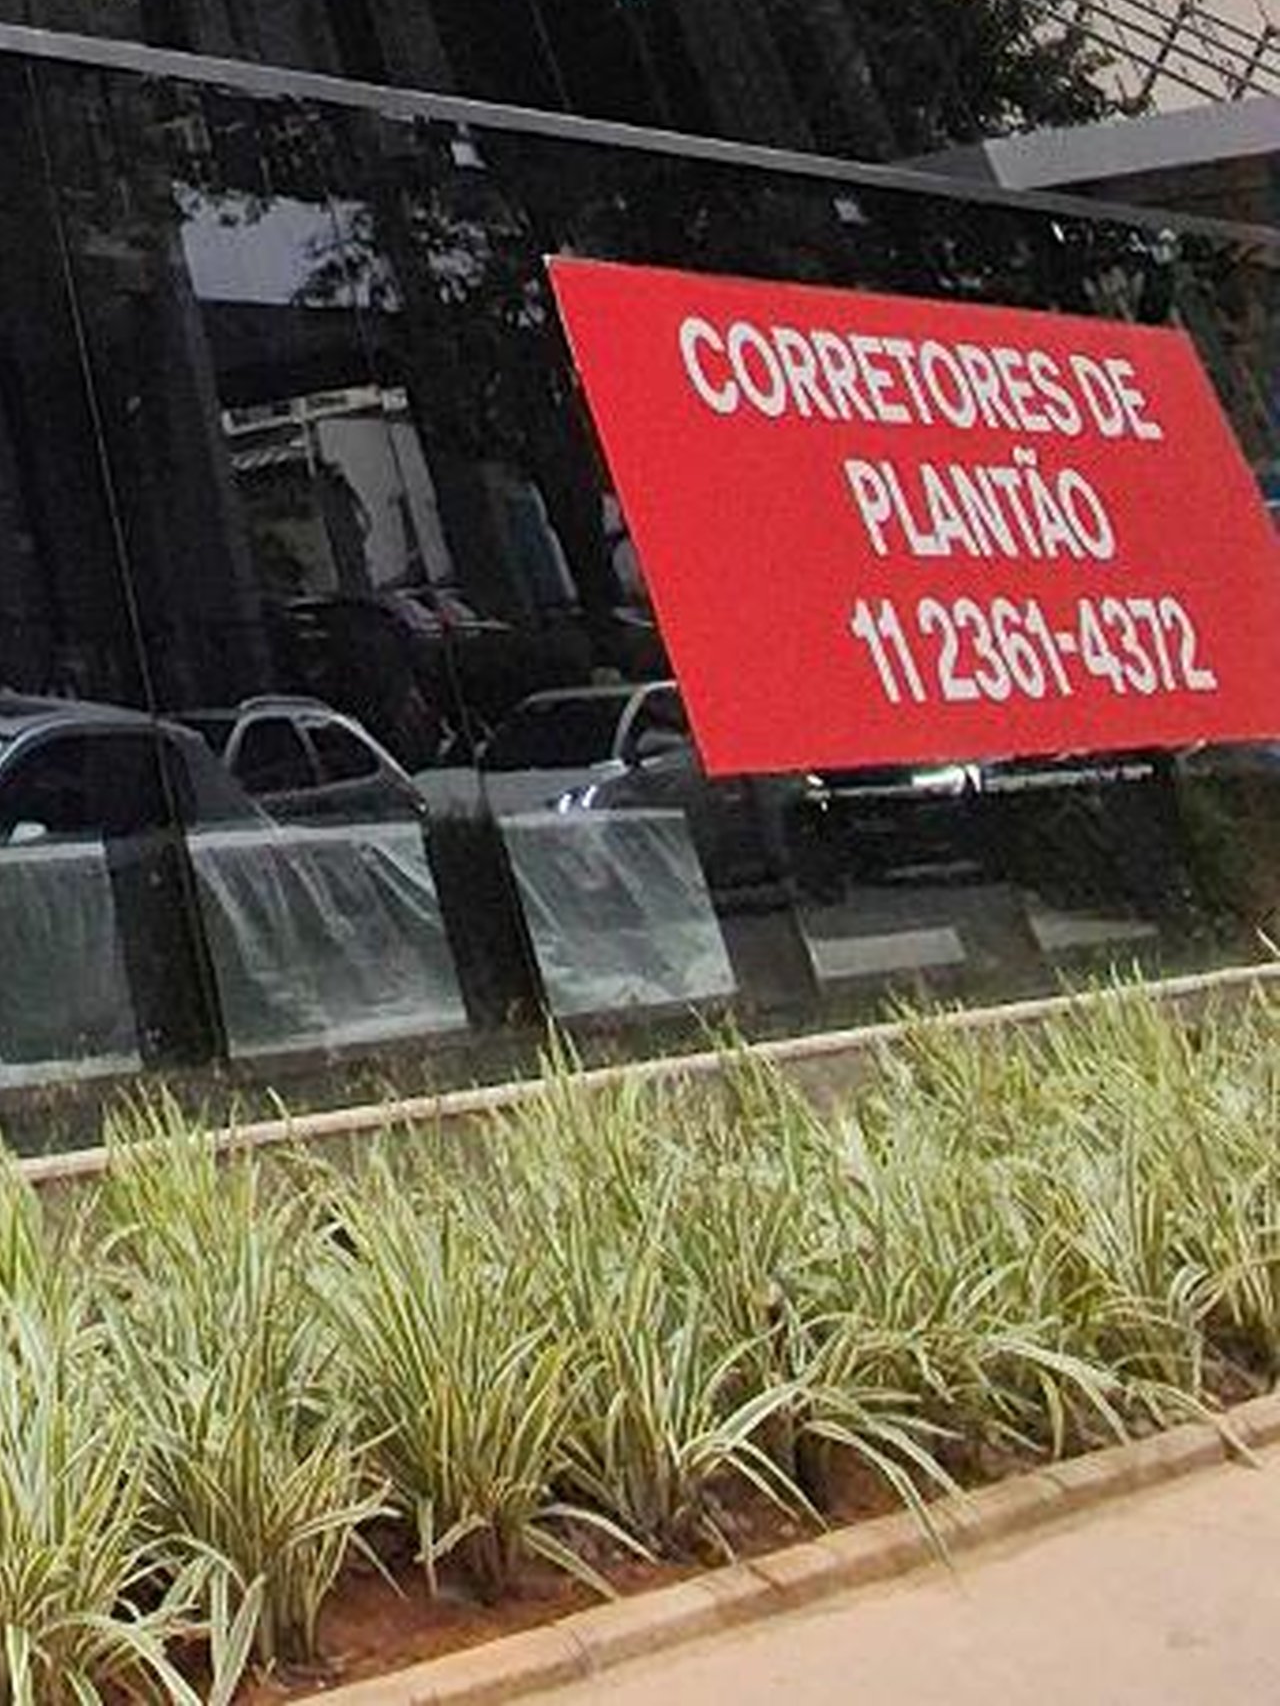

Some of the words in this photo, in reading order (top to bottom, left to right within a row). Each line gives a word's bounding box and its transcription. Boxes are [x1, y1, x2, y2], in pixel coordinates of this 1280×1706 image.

[677, 316, 1084, 437] CORRETORES
[1068, 354, 1163, 441] DE
[843, 445, 1117, 561] PLANTÃO
[850, 598, 926, 704] 11
[916, 596, 1218, 702] 2361-4372
